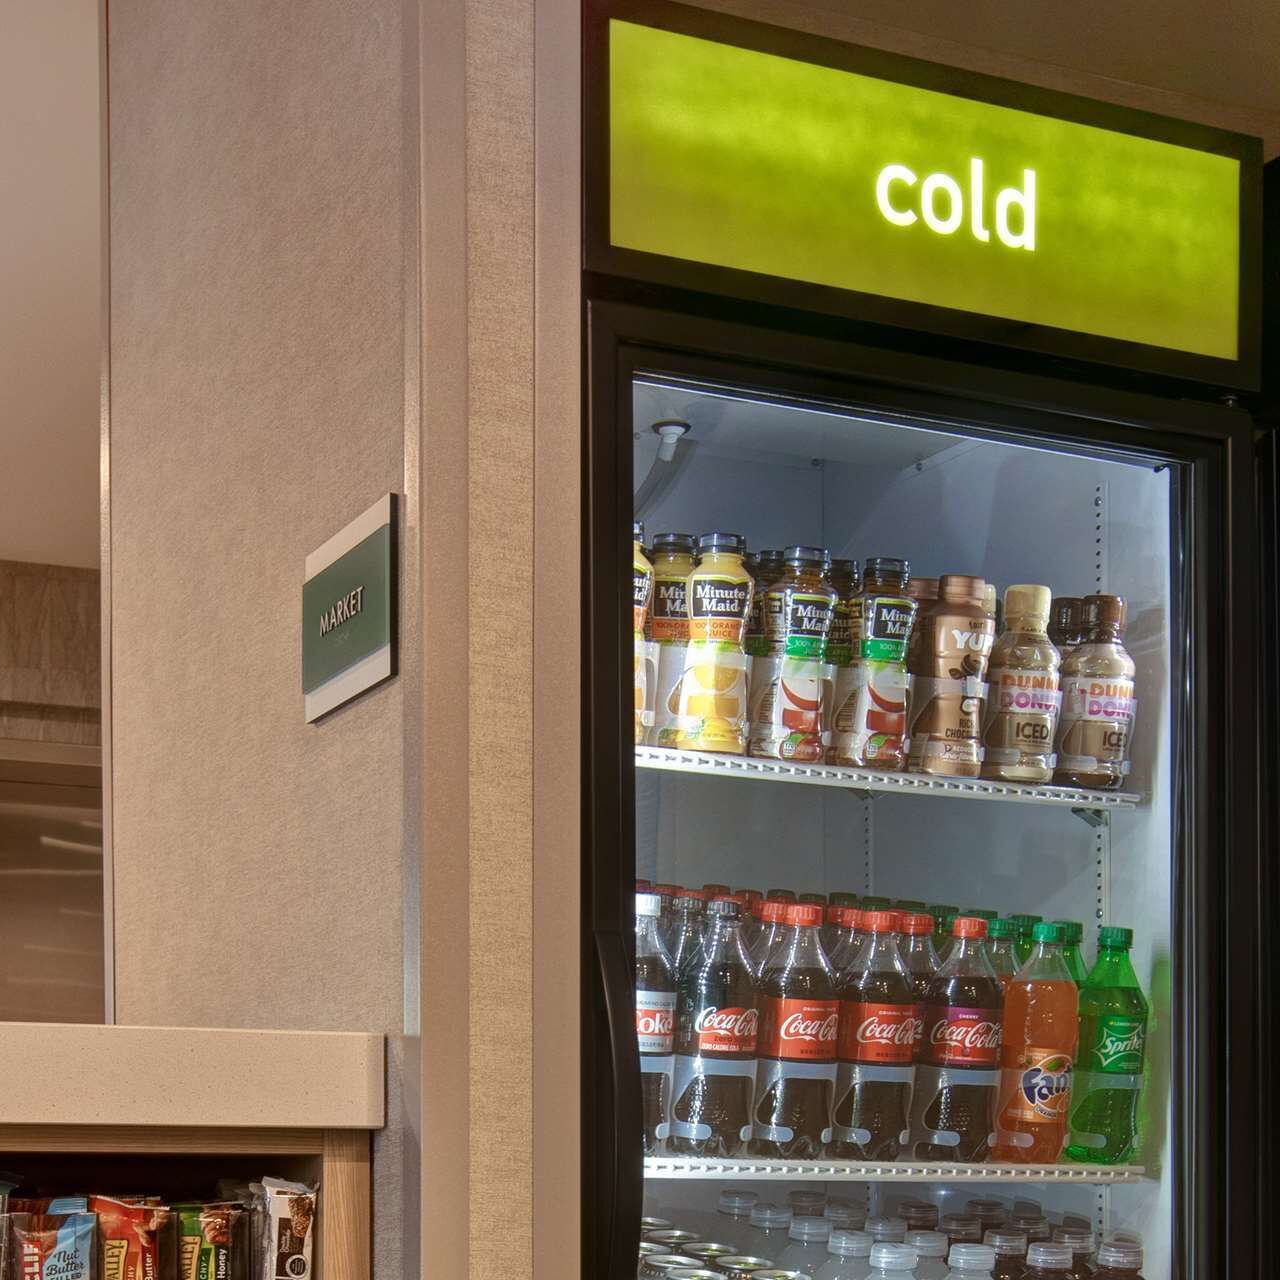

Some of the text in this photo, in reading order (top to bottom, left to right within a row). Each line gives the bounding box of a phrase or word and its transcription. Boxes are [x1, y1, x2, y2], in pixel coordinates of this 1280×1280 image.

[875, 157, 1037, 251] cold
[696, 584, 745, 600] Minute
[320, 586, 364, 637] MARKET
[702, 598, 739, 612] Maid
[1015, 722, 1050, 740] ICED
[930, 1019, 998, 1049] Coca-Cola
[54, 1248, 81, 1264] Nut
[217, 1248, 228, 1279] Honey
[46, 1261, 84, 1277] Butter
